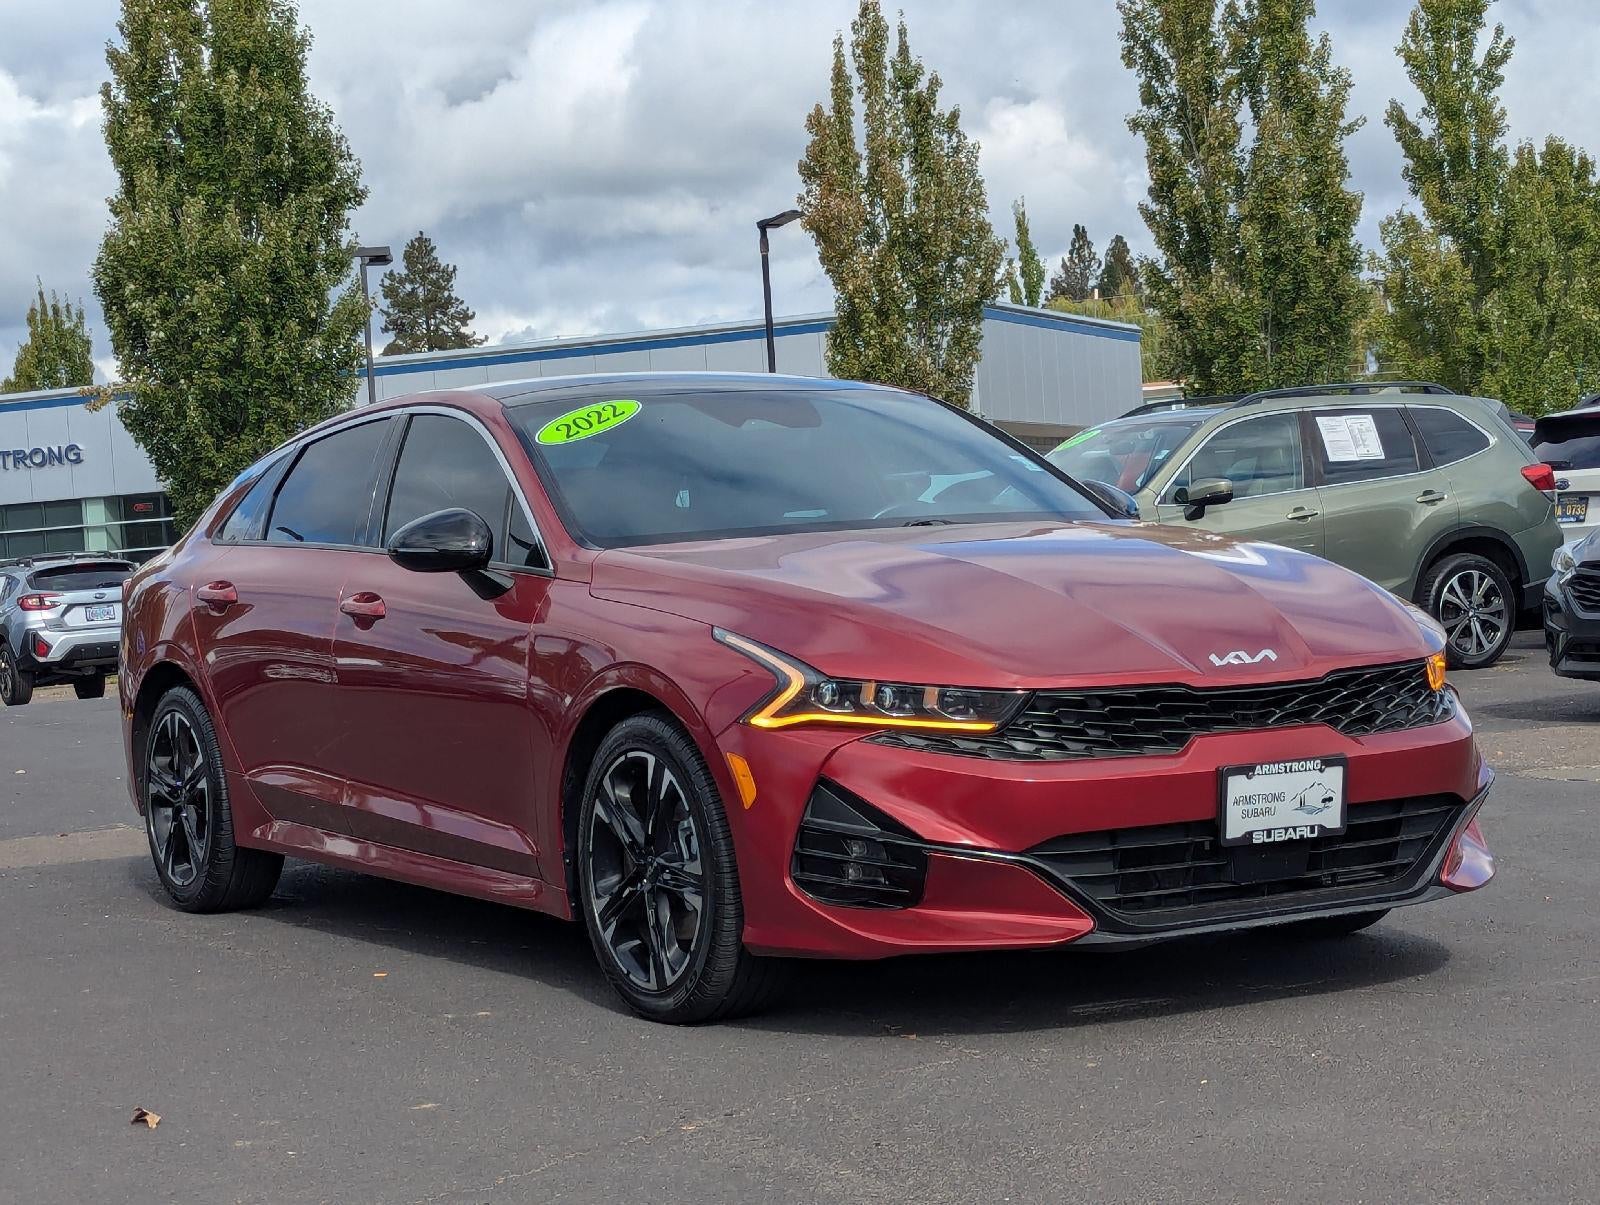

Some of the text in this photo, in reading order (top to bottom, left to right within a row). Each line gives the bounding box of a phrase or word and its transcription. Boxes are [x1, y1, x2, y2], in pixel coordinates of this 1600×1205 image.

[556, 404, 625, 439] 2022
[1254, 759, 1321, 775] ARMSTRONG
[1232, 791, 1286, 806] ARMSTRONG
[1241, 806, 1277, 820] SUBARU
[1252, 825, 1318, 844] SUBARU
